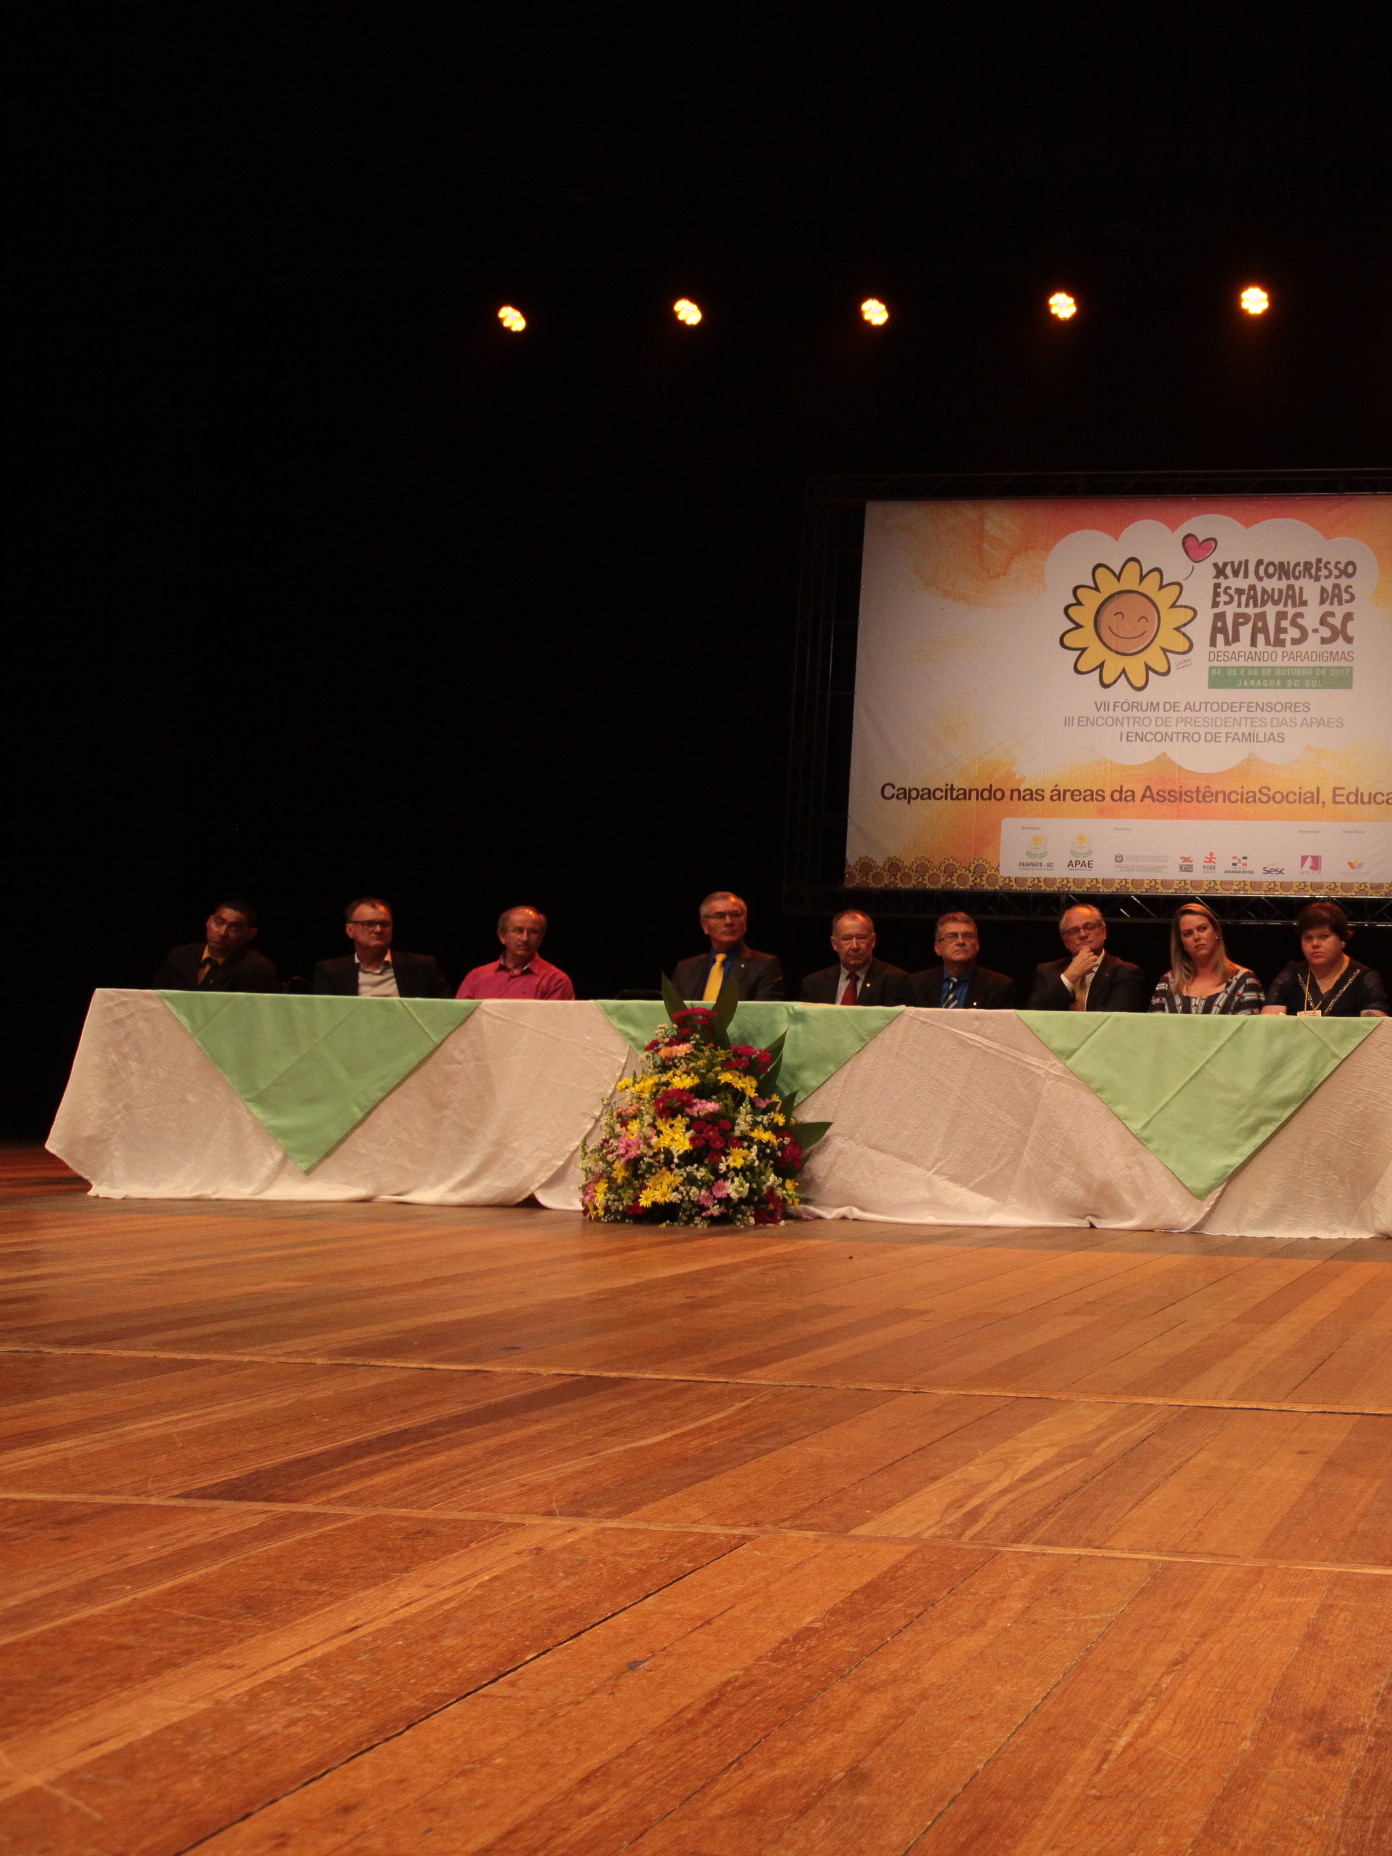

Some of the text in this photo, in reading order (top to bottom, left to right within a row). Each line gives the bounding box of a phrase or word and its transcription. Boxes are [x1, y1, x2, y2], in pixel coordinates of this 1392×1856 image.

[1212, 558, 1357, 582] XVI CONGRESSO
[1211, 583, 1356, 609] ESTADUAL DAS
[1209, 611, 1355, 648] APAES-SC
[1209, 651, 1354, 662] DESAFIANDO PARADIGMAS
[1228, 668, 1237, 676] 05
[1241, 668, 1245, 676] E
[1248, 668, 1258, 676] 06
[1094, 699, 1310, 713] VII FÓRUM DE AUTODEFENSORES
[1064, 717, 1344, 729] III ENCONTRO DE PRESIDENTES DAS APAES
[1126, 732, 1201, 743] ENCONTRO
[1204, 732, 1222, 743] DE
[1225, 729, 1285, 744] FAMÍLIAS
[880, 783, 1005, 805] Capacitando
[1010, 789, 1044, 802] nas
[1050, 784, 1105, 802] áreas
[1110, 785, 1135, 803] da
[1140, 785, 1326, 808] AssistênciaSocial,
[1067, 860, 1094, 868] APAE
